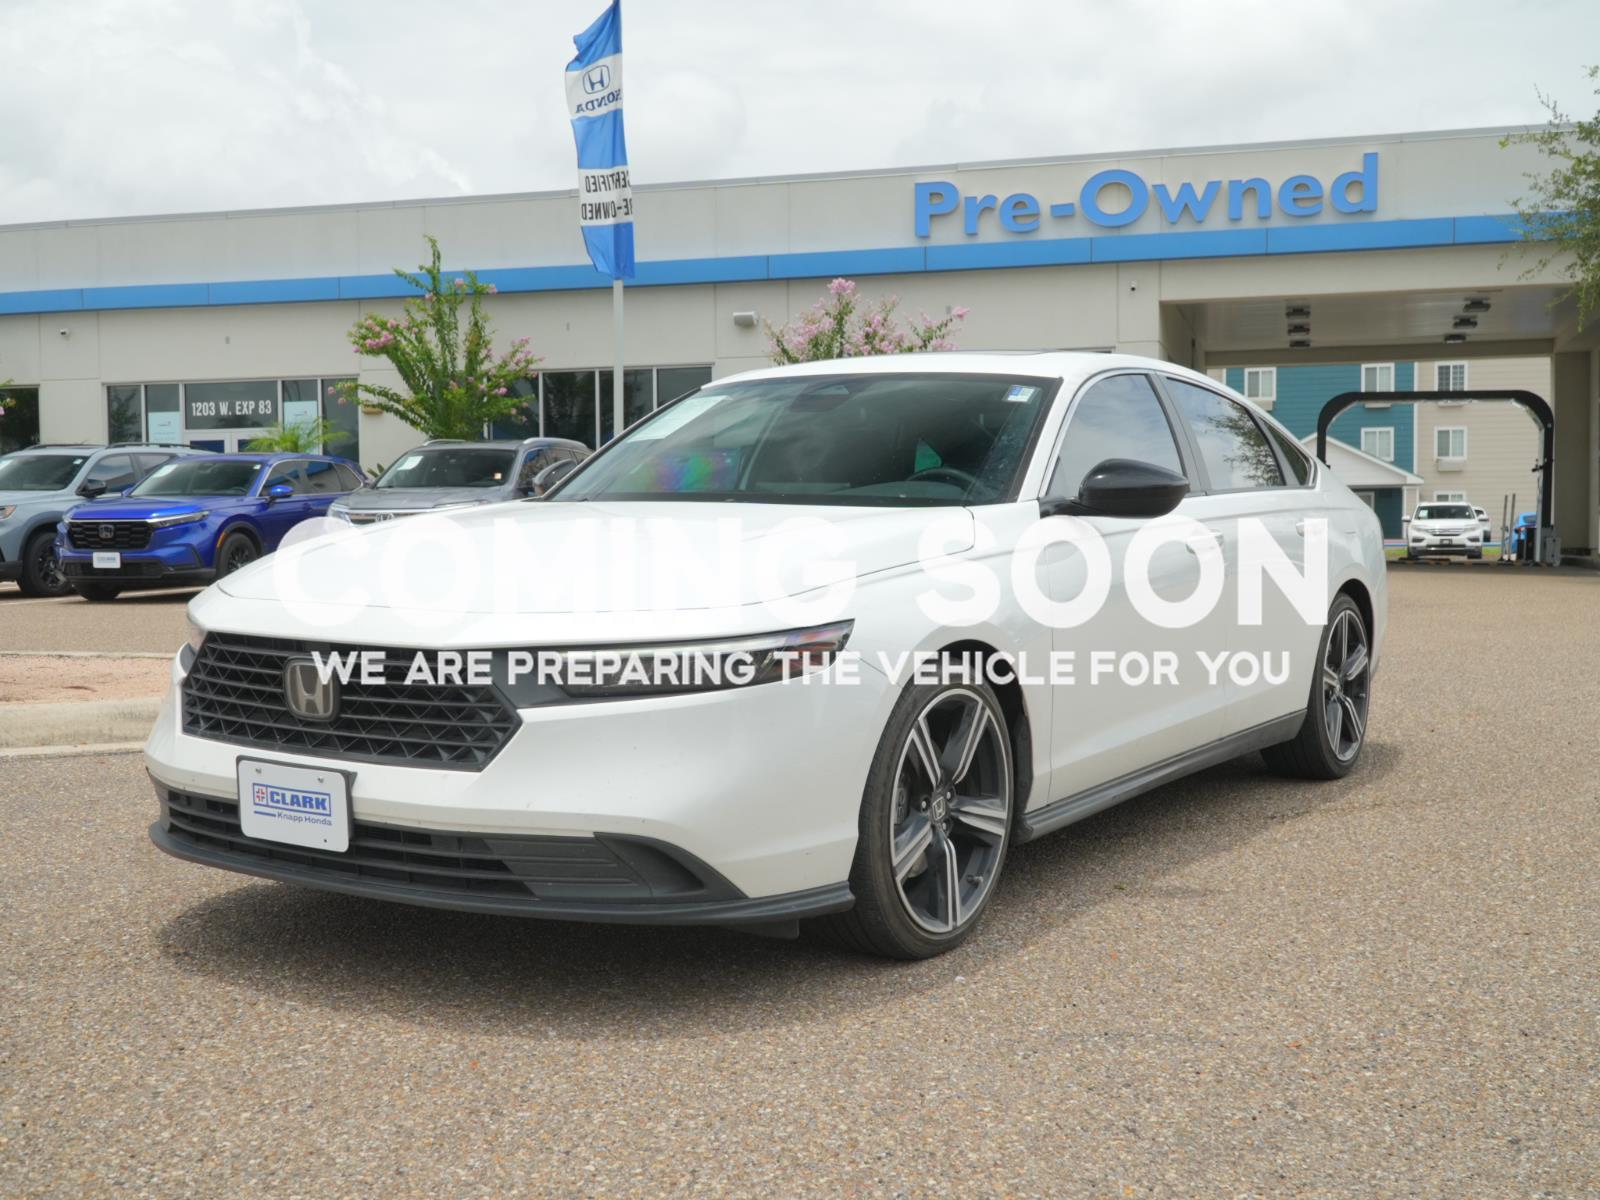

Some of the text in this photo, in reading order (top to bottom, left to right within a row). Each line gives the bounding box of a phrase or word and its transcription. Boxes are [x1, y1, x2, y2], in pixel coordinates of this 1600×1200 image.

[914, 152, 1379, 238] Pre-Owned
[191, 400, 272, 416] 1203 W. EXP 83
[269, 790, 328, 811] CLARK
[277, 812, 333, 826] Knapp Honda
